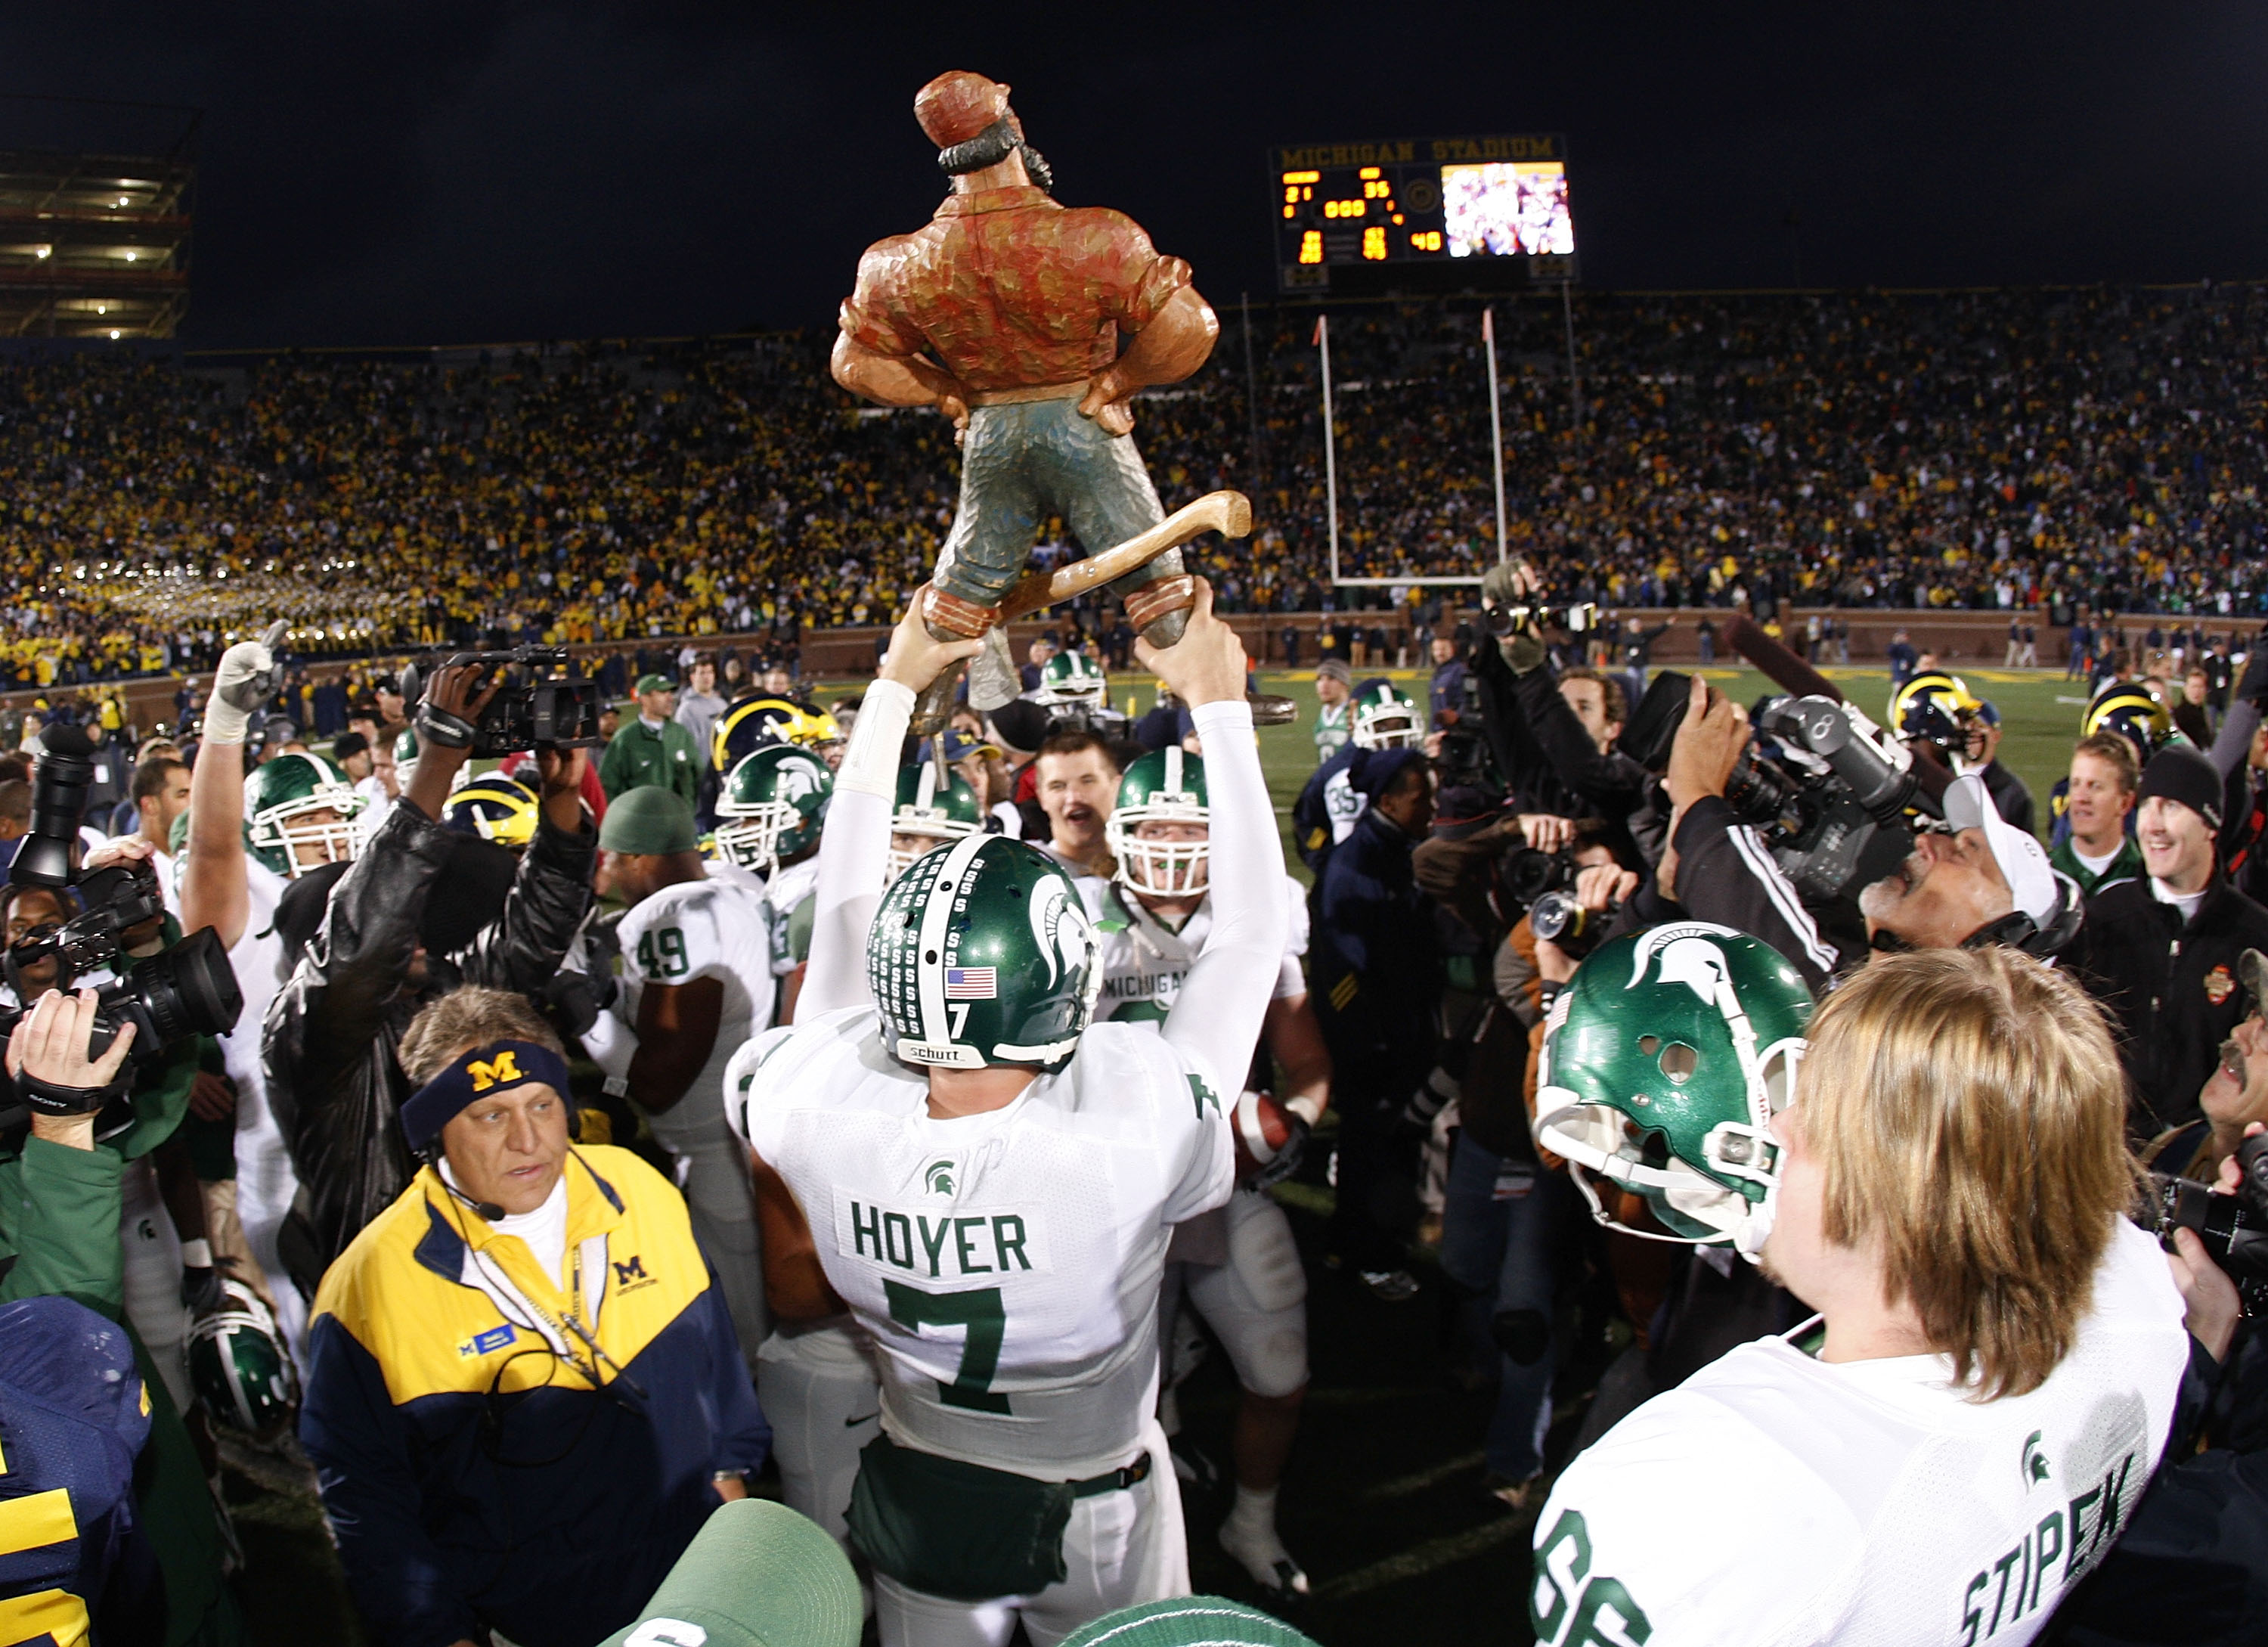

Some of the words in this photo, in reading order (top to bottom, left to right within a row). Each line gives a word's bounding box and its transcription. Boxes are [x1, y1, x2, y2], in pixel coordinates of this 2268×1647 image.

[1281, 141, 1414, 168] MICHIGAN
[1433, 137, 1554, 160] STADIUM
[638, 926, 689, 979] 49
[1103, 970, 1187, 997] MICHIGA
[948, 1003, 971, 1039] 7
[466, 1050, 522, 1092] M
[850, 1200, 1033, 1276] HOYER
[612, 1255, 647, 1285] M
[881, 1278, 1013, 1416] 7
[1960, 1451, 2135, 1647] STIPEK
